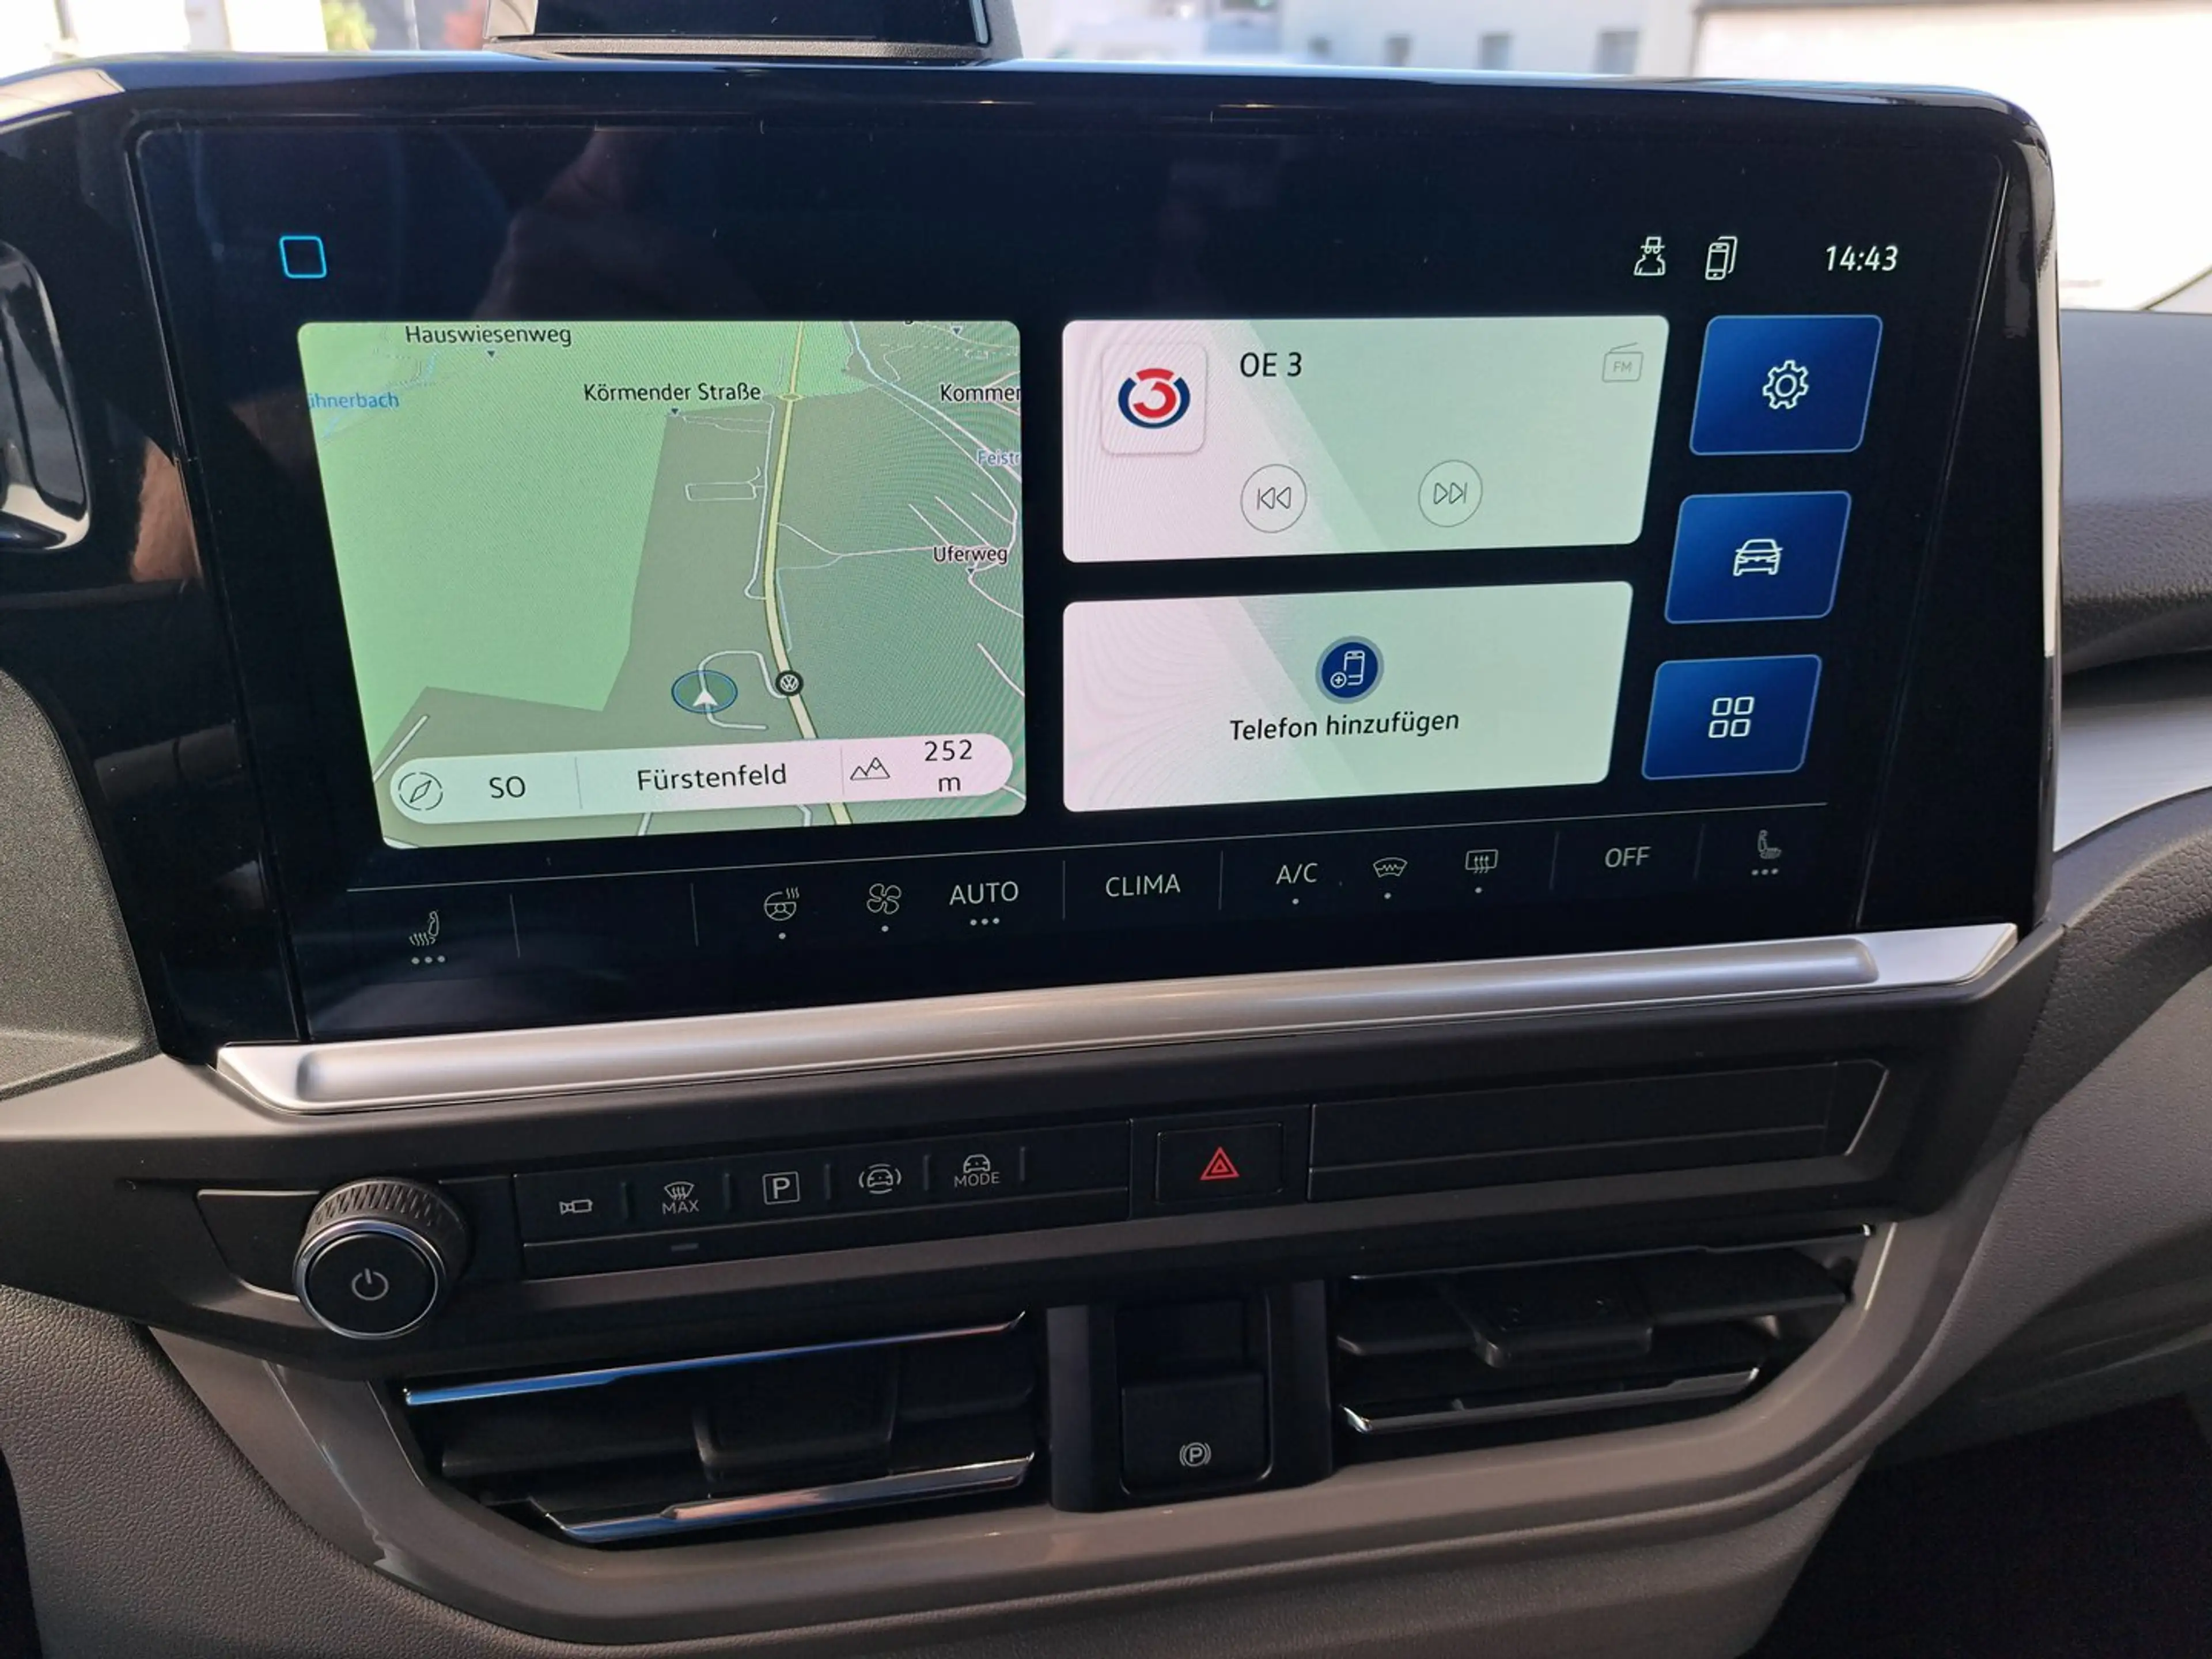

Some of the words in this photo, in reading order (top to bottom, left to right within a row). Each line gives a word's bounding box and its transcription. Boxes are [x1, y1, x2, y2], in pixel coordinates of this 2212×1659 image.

[1825, 244, 1899, 272] 14:43
[405, 325, 572, 347] Hauswiesenweg
[1240, 352, 1278, 377] OE
[1287, 351, 1302, 377] 3
[1613, 361, 1633, 373] FM
[584, 382, 691, 402] Körmender
[698, 382, 762, 401] Straße
[934, 546, 1007, 565] Uferweg
[1229, 717, 1318, 741] Telefon
[1326, 711, 1460, 737] hinzufügen
[924, 739, 972, 762] 252
[489, 775, 527, 799] SO
[637, 763, 787, 791] Fürstenfeld
[938, 777, 961, 793] m
[1604, 846, 1652, 868] OFF
[1275, 862, 1319, 885] A/C
[949, 881, 1019, 906] AUTO
[1105, 873, 1181, 897] CLIMA
[772, 1177, 790, 1199] P
[953, 1172, 1001, 1187] MODE
[662, 1199, 700, 1214] MAX
